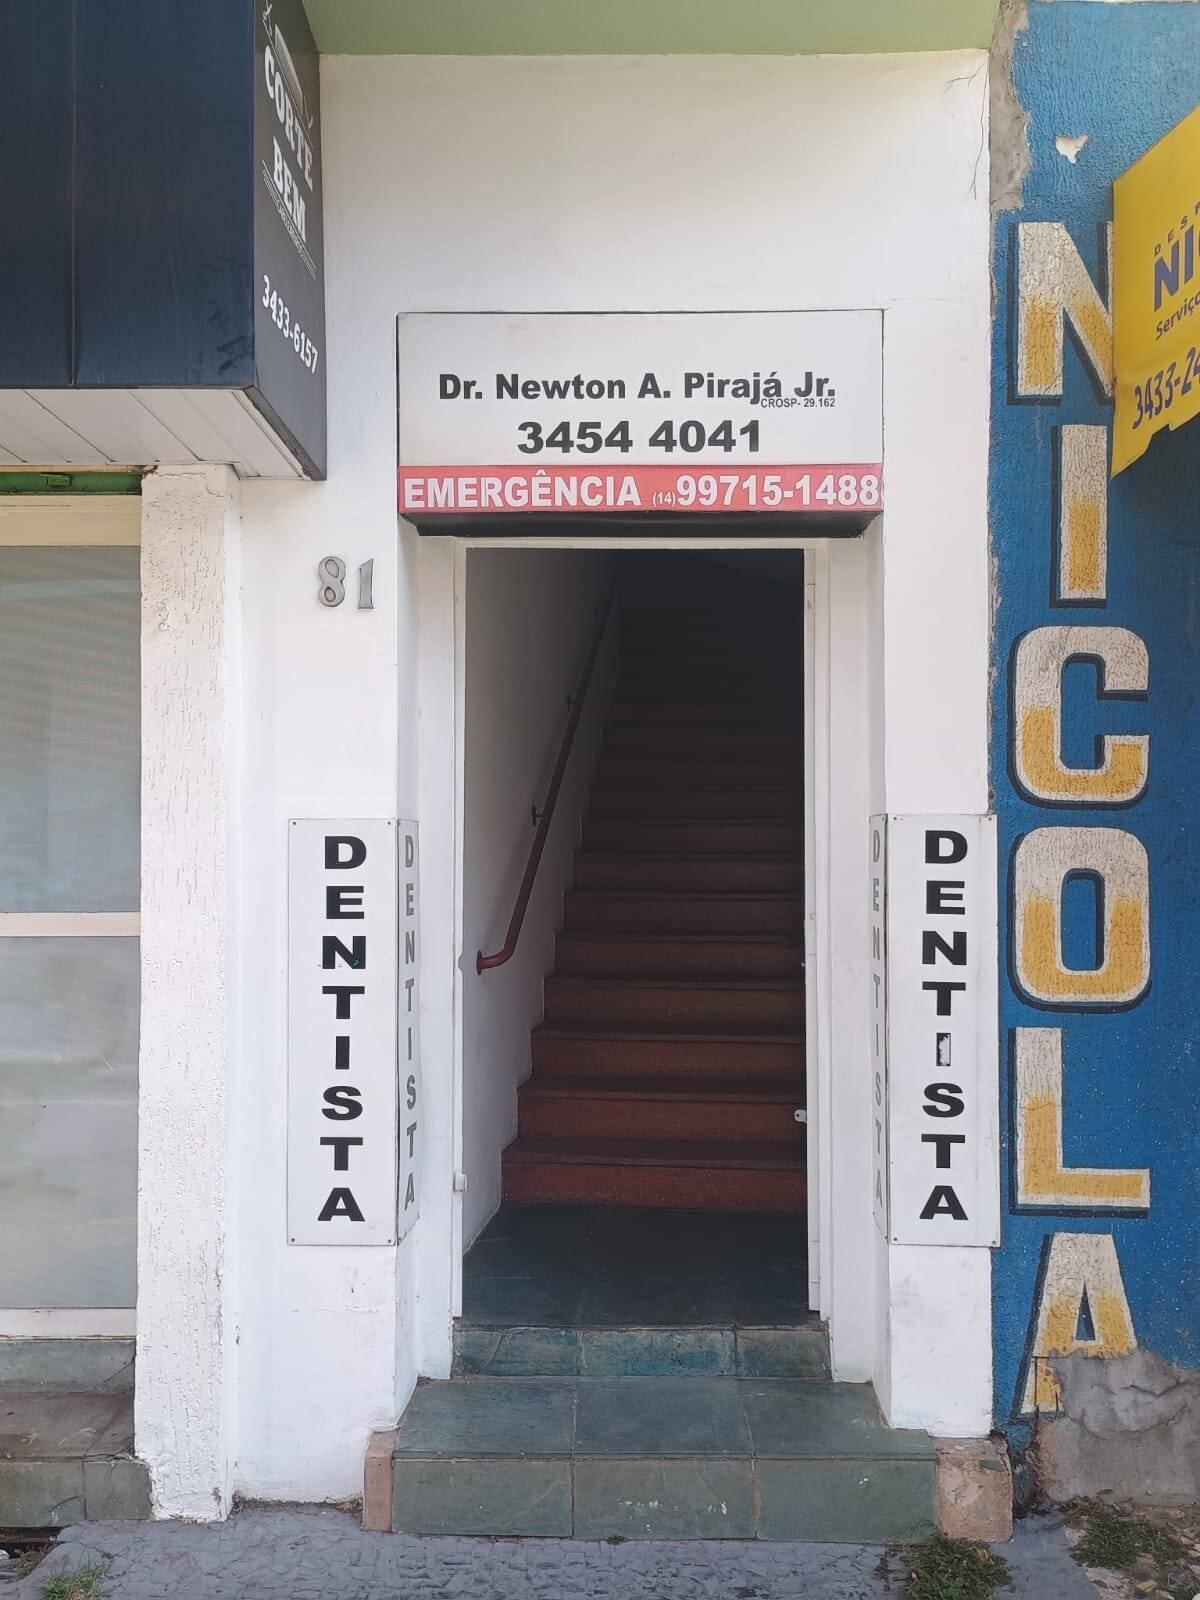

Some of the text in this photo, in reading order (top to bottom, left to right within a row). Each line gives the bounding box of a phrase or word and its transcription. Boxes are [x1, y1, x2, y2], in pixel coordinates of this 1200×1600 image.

[264, 45, 313, 192] CORTE
[273, 136, 306, 243] BEM
[1154, 225, 1200, 313] NI
[262, 274, 318, 374] 3433-6157
[440, 372, 836, 405] Dr. Newton A. Pirajá Jr.
[518, 420, 759, 454] 3454 4041
[803, 398, 835, 408] 29.162
[404, 470, 641, 508] EMERGÊNCIA
[318, 556, 374, 609] 81
[317, 836, 367, 1222] DENTISTA
[405, 835, 417, 1213] DENTISTA
[872, 830, 884, 1210] DENTISTA
[919, 830, 969, 1220] DENTISTA
